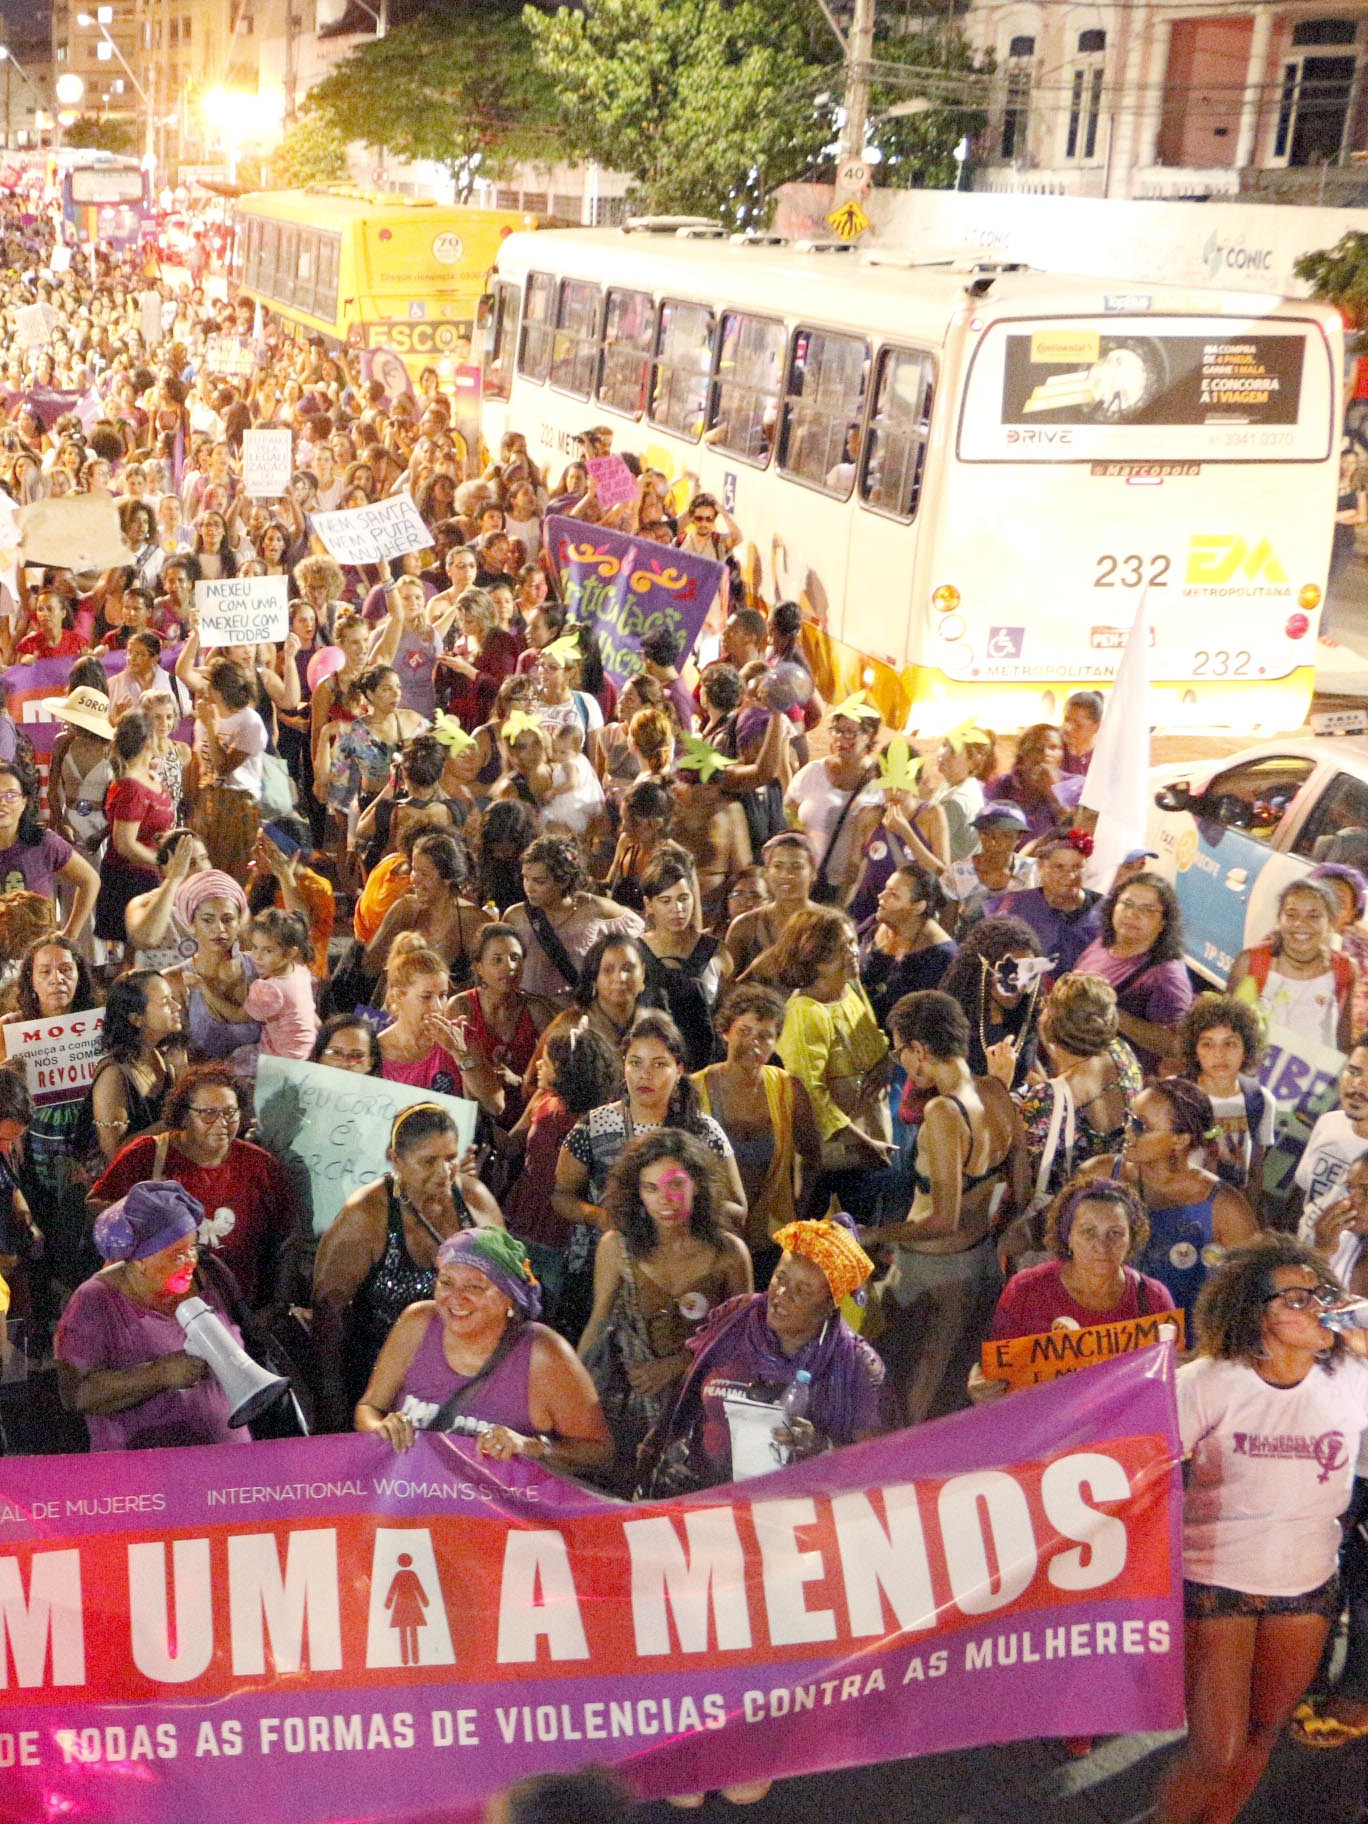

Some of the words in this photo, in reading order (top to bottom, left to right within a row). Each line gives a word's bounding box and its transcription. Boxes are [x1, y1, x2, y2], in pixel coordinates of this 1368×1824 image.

[844, 167, 864, 179] 40
[439, 237, 459, 247] 70
[1226, 249, 1273, 270] CONIC
[369, 324, 465, 350] ESCO
[1202, 379, 1210, 391] E
[1211, 379, 1279, 391] CONCORRA
[1200, 392, 1211, 403] A
[1220, 391, 1269, 403] VIAGEM
[1006, 430, 1072, 444] DRIVE
[1106, 463, 1200, 476] Marcopolo
[319, 517, 354, 536] NEM
[356, 501, 417, 527] SANTA
[329, 534, 367, 550] NEM
[370, 520, 416, 543] PUTA
[349, 532, 421, 563] MULHER
[1093, 555, 1171, 588] 232
[207, 583, 251, 598] MEXEU
[1182, 586, 1292, 598] METROPOLITANA
[218, 600, 247, 612] COM
[202, 614, 248, 630] MEXEU
[253, 613, 280, 627] COM
[224, 627, 271, 642] TODAS
[1192, 651, 1252, 676] 232
[22, 1018, 105, 1044] MOÇA
[12, 1045, 57, 1060] esqueça
[34, 1056, 58, 1068] NÓS
[334, 1093, 398, 1120] CORPO
[996, 1340, 1013, 1368] É
[207, 1480, 368, 1506] INTERNATIONAL
[373, 1478, 476, 1501] WOMAN'S
[479, 1483, 540, 1502] STRIKE
[34, 1501, 61, 1520] DE
[66, 1493, 166, 1517] MUJERES
[128, 1527, 457, 1684] UMA
[497, 1529, 591, 1665] A
[624, 1452, 1132, 1658] MENOS
[56, 1722, 178, 1764] TODAS
[195, 1719, 242, 1758] AS
[260, 1712, 416, 1756] FORMAS
[433, 1708, 480, 1747] DE
[495, 1693, 725, 1743] VIOLENCIAS
[743, 1667, 886, 1724] CONTRA
[903, 1649, 947, 1684] AS
[965, 1619, 1170, 1671] MULHERES
